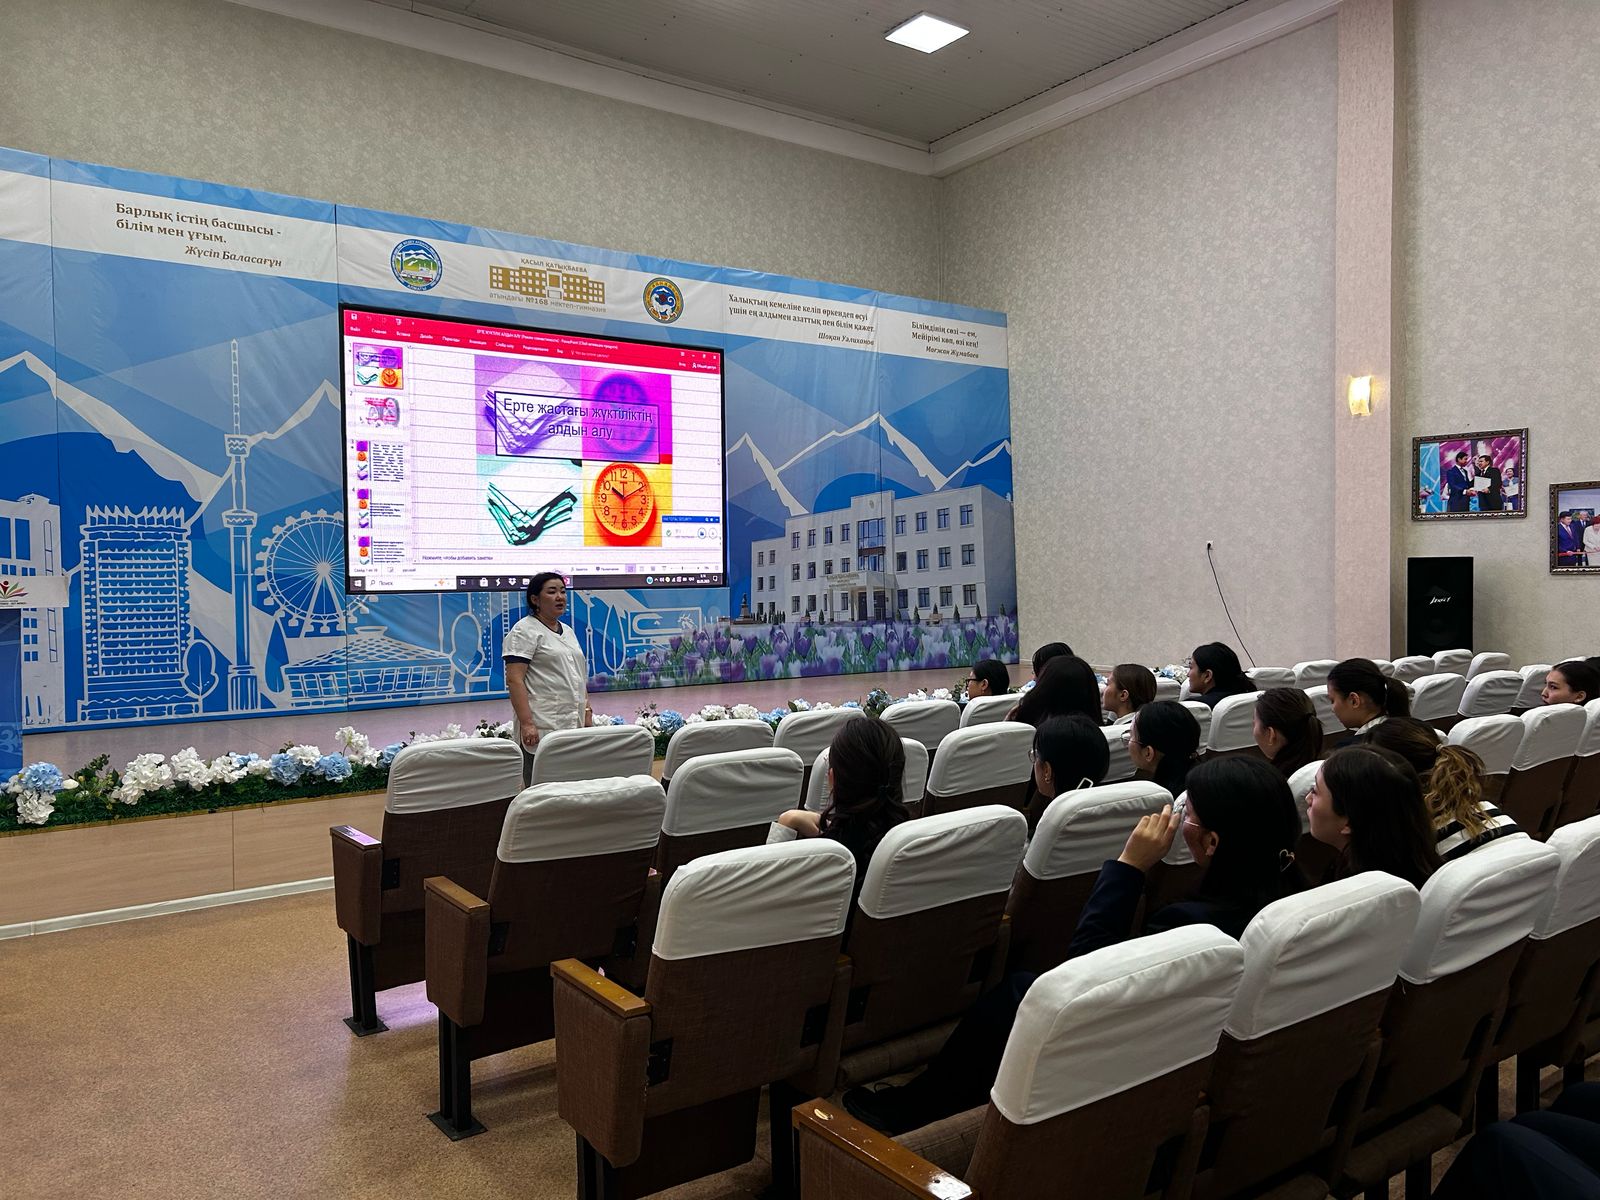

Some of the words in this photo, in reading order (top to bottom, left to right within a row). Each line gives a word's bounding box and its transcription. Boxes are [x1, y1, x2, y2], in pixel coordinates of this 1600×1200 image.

[116, 203, 173, 222] Барлық
[176, 212, 208, 227] істің
[212, 217, 274, 235] басшысы
[116, 219, 154, 232] білім
[158, 227, 184, 237] мен
[185, 245, 220, 258] Жүсіп
[521, 258, 544, 266] ҚАСЫЛ
[526, 297, 549, 306] №168
[729, 294, 768, 306] Халықтың
[769, 302, 801, 311] кемеліне
[802, 306, 821, 314] келіп
[729, 306, 747, 316] үшін
[759, 311, 791, 321] алдымен
[792, 316, 821, 326] азаттық
[836, 320, 853, 329] білім
[818, 332, 840, 342] Шоқан
[504, 398, 534, 415] Ерте
[538, 403, 588, 416] жастағы
[592, 407, 653, 423] жүктіліктің
[548, 423, 588, 437] алдын
[591, 426, 613, 440] алу
[611, 472, 617, 481] 11
[620, 469, 627, 479] 12
[603, 481, 611, 491] 10
[601, 493, 606, 502] 9
[641, 495, 646, 504] 3
[604, 506, 610, 516] 8
[639, 507, 644, 516] 4
[612, 516, 617, 525] 7
[622, 519, 627, 528] 6
[632, 516, 636, 525] 5
